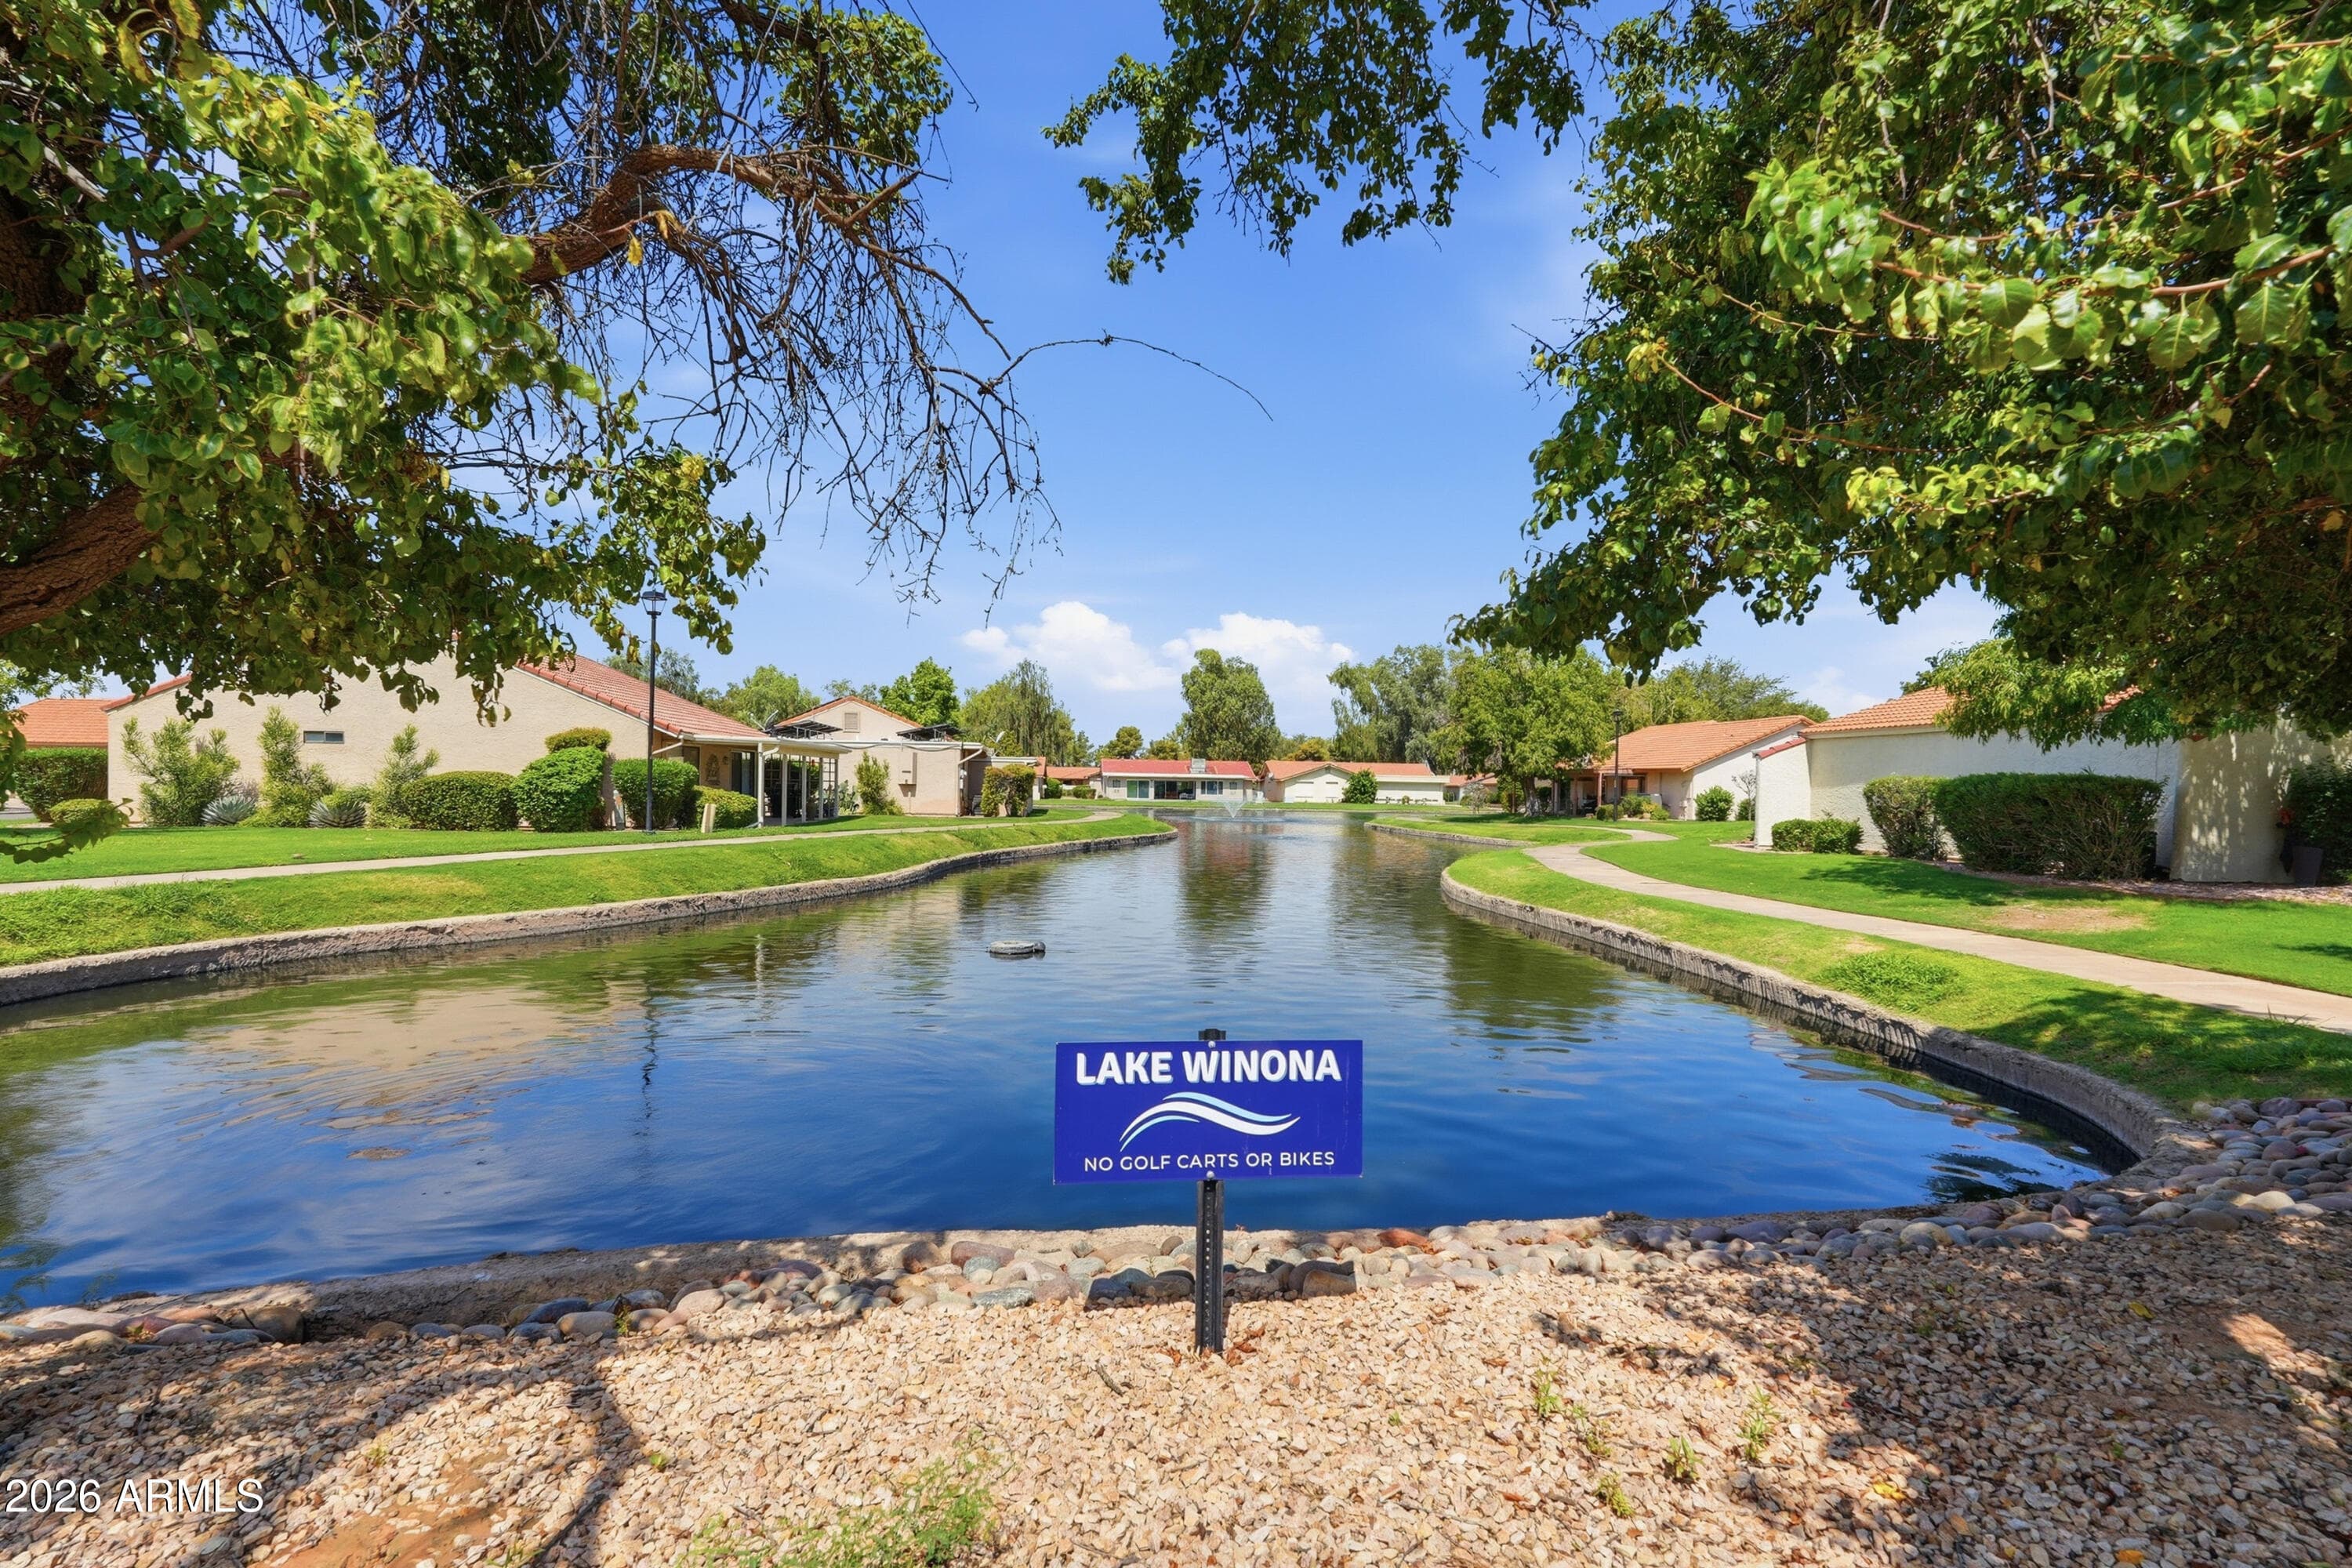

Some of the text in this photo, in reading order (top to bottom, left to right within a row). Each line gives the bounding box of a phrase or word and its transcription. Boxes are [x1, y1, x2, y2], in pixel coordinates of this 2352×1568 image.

[1076, 1049, 1342, 1085] LAKE WINONA
[1084, 1151, 1335, 1172] NO GOLF CARTS OR BIKES
